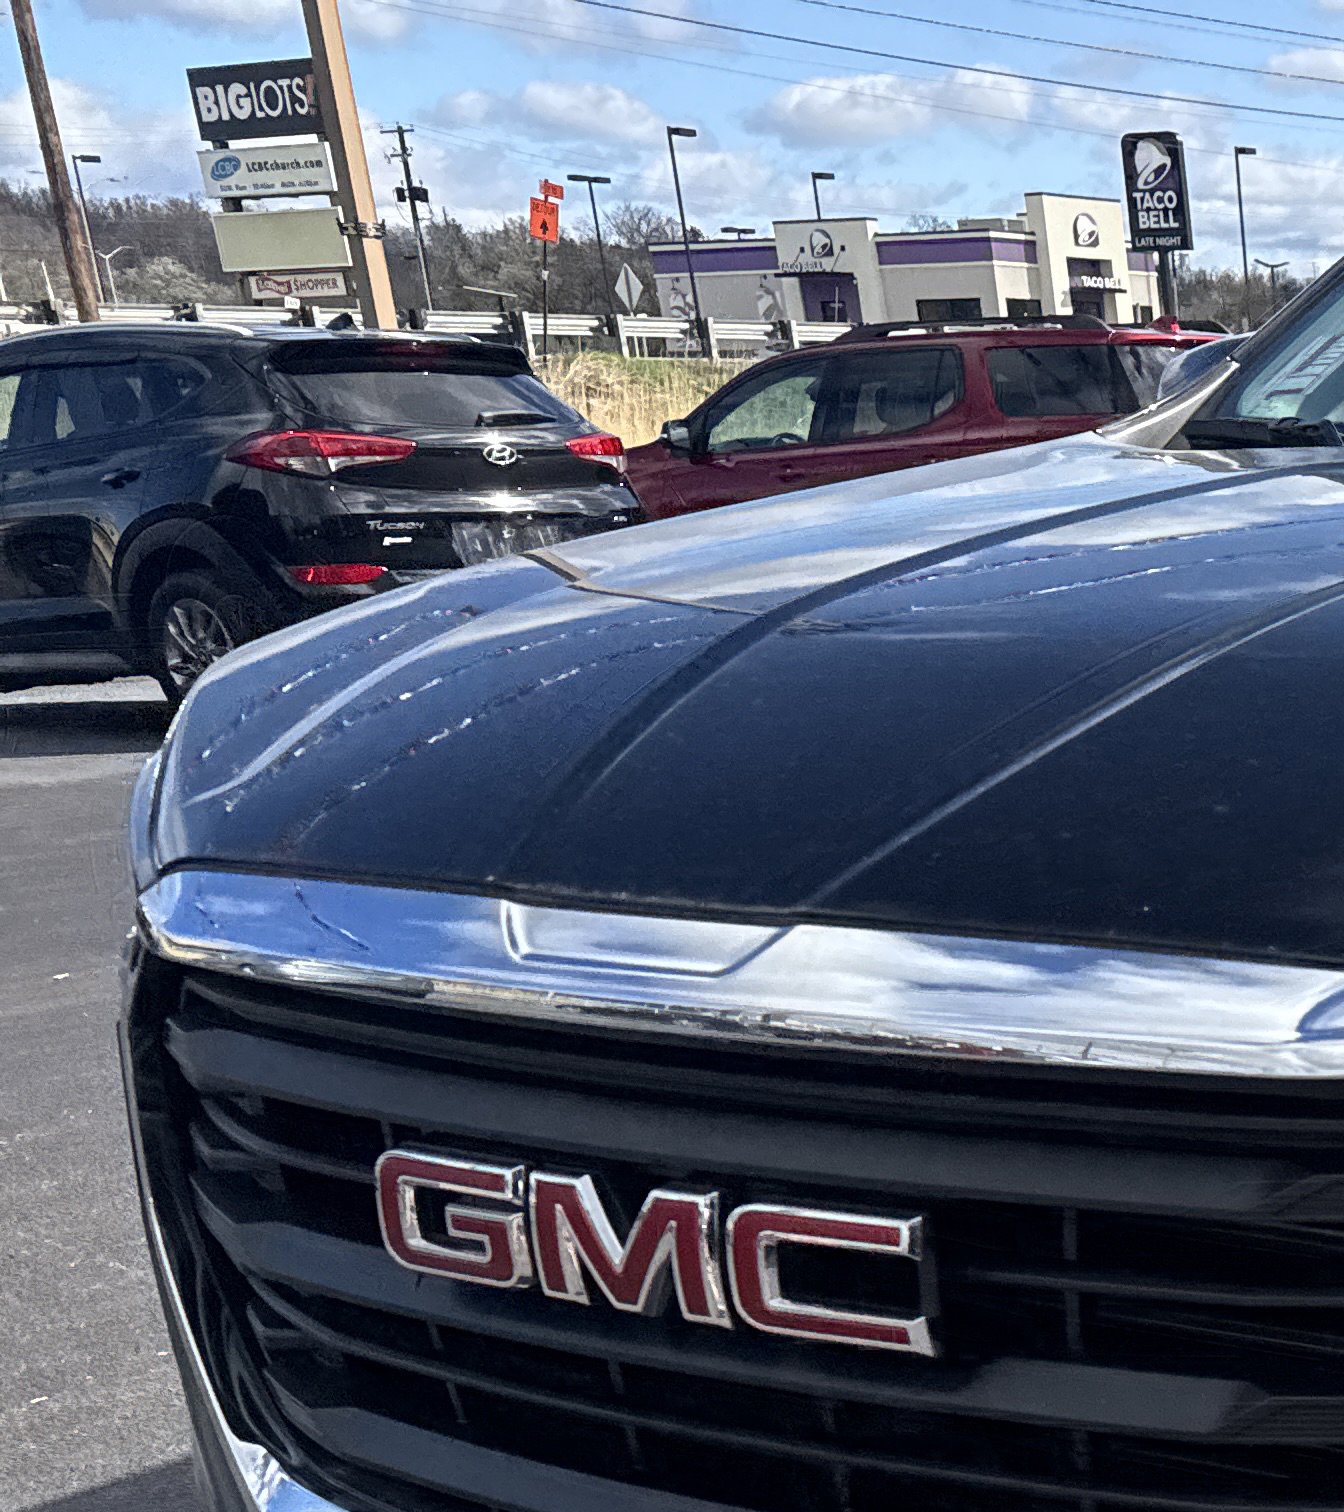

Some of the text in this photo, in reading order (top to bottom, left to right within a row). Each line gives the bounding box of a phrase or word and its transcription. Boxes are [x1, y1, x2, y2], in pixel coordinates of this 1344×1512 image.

[1132, 190, 1177, 210] TACO
[1138, 210, 1180, 229] BELL
[1136, 236, 1181, 247] LATE NIGHT
[1081, 275, 1124, 290] TACO BEL
[375, 1149, 937, 1358] GMC
